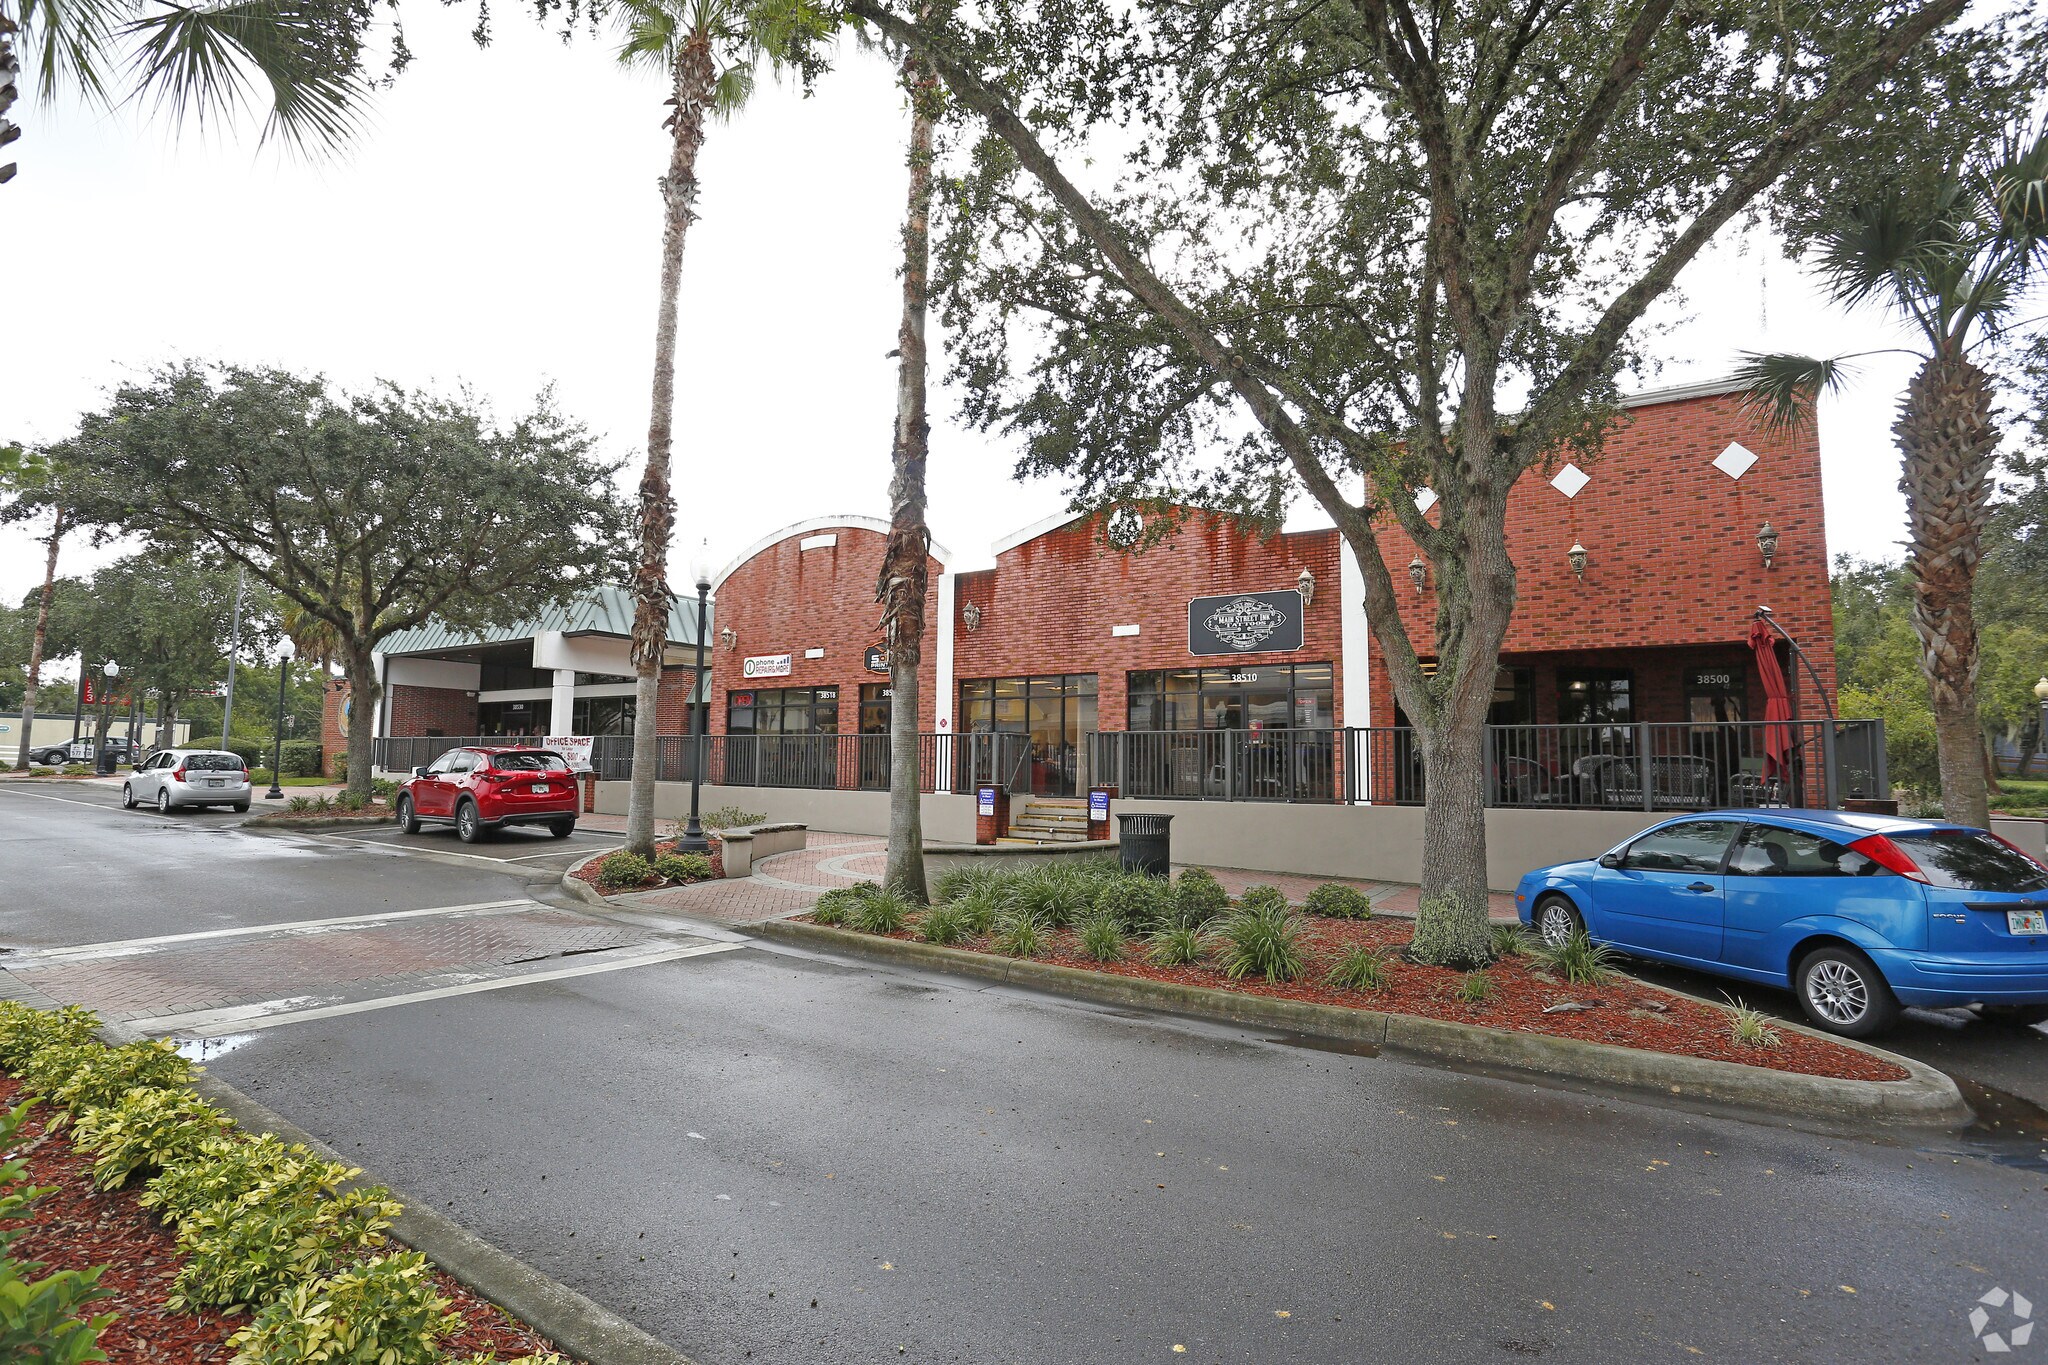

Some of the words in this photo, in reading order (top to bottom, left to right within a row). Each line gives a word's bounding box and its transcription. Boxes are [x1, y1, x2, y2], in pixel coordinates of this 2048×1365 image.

[1231, 672, 1258, 682] 38510
[1697, 674, 1730, 684] 38500
[546, 737, 569, 746] OFFICE
